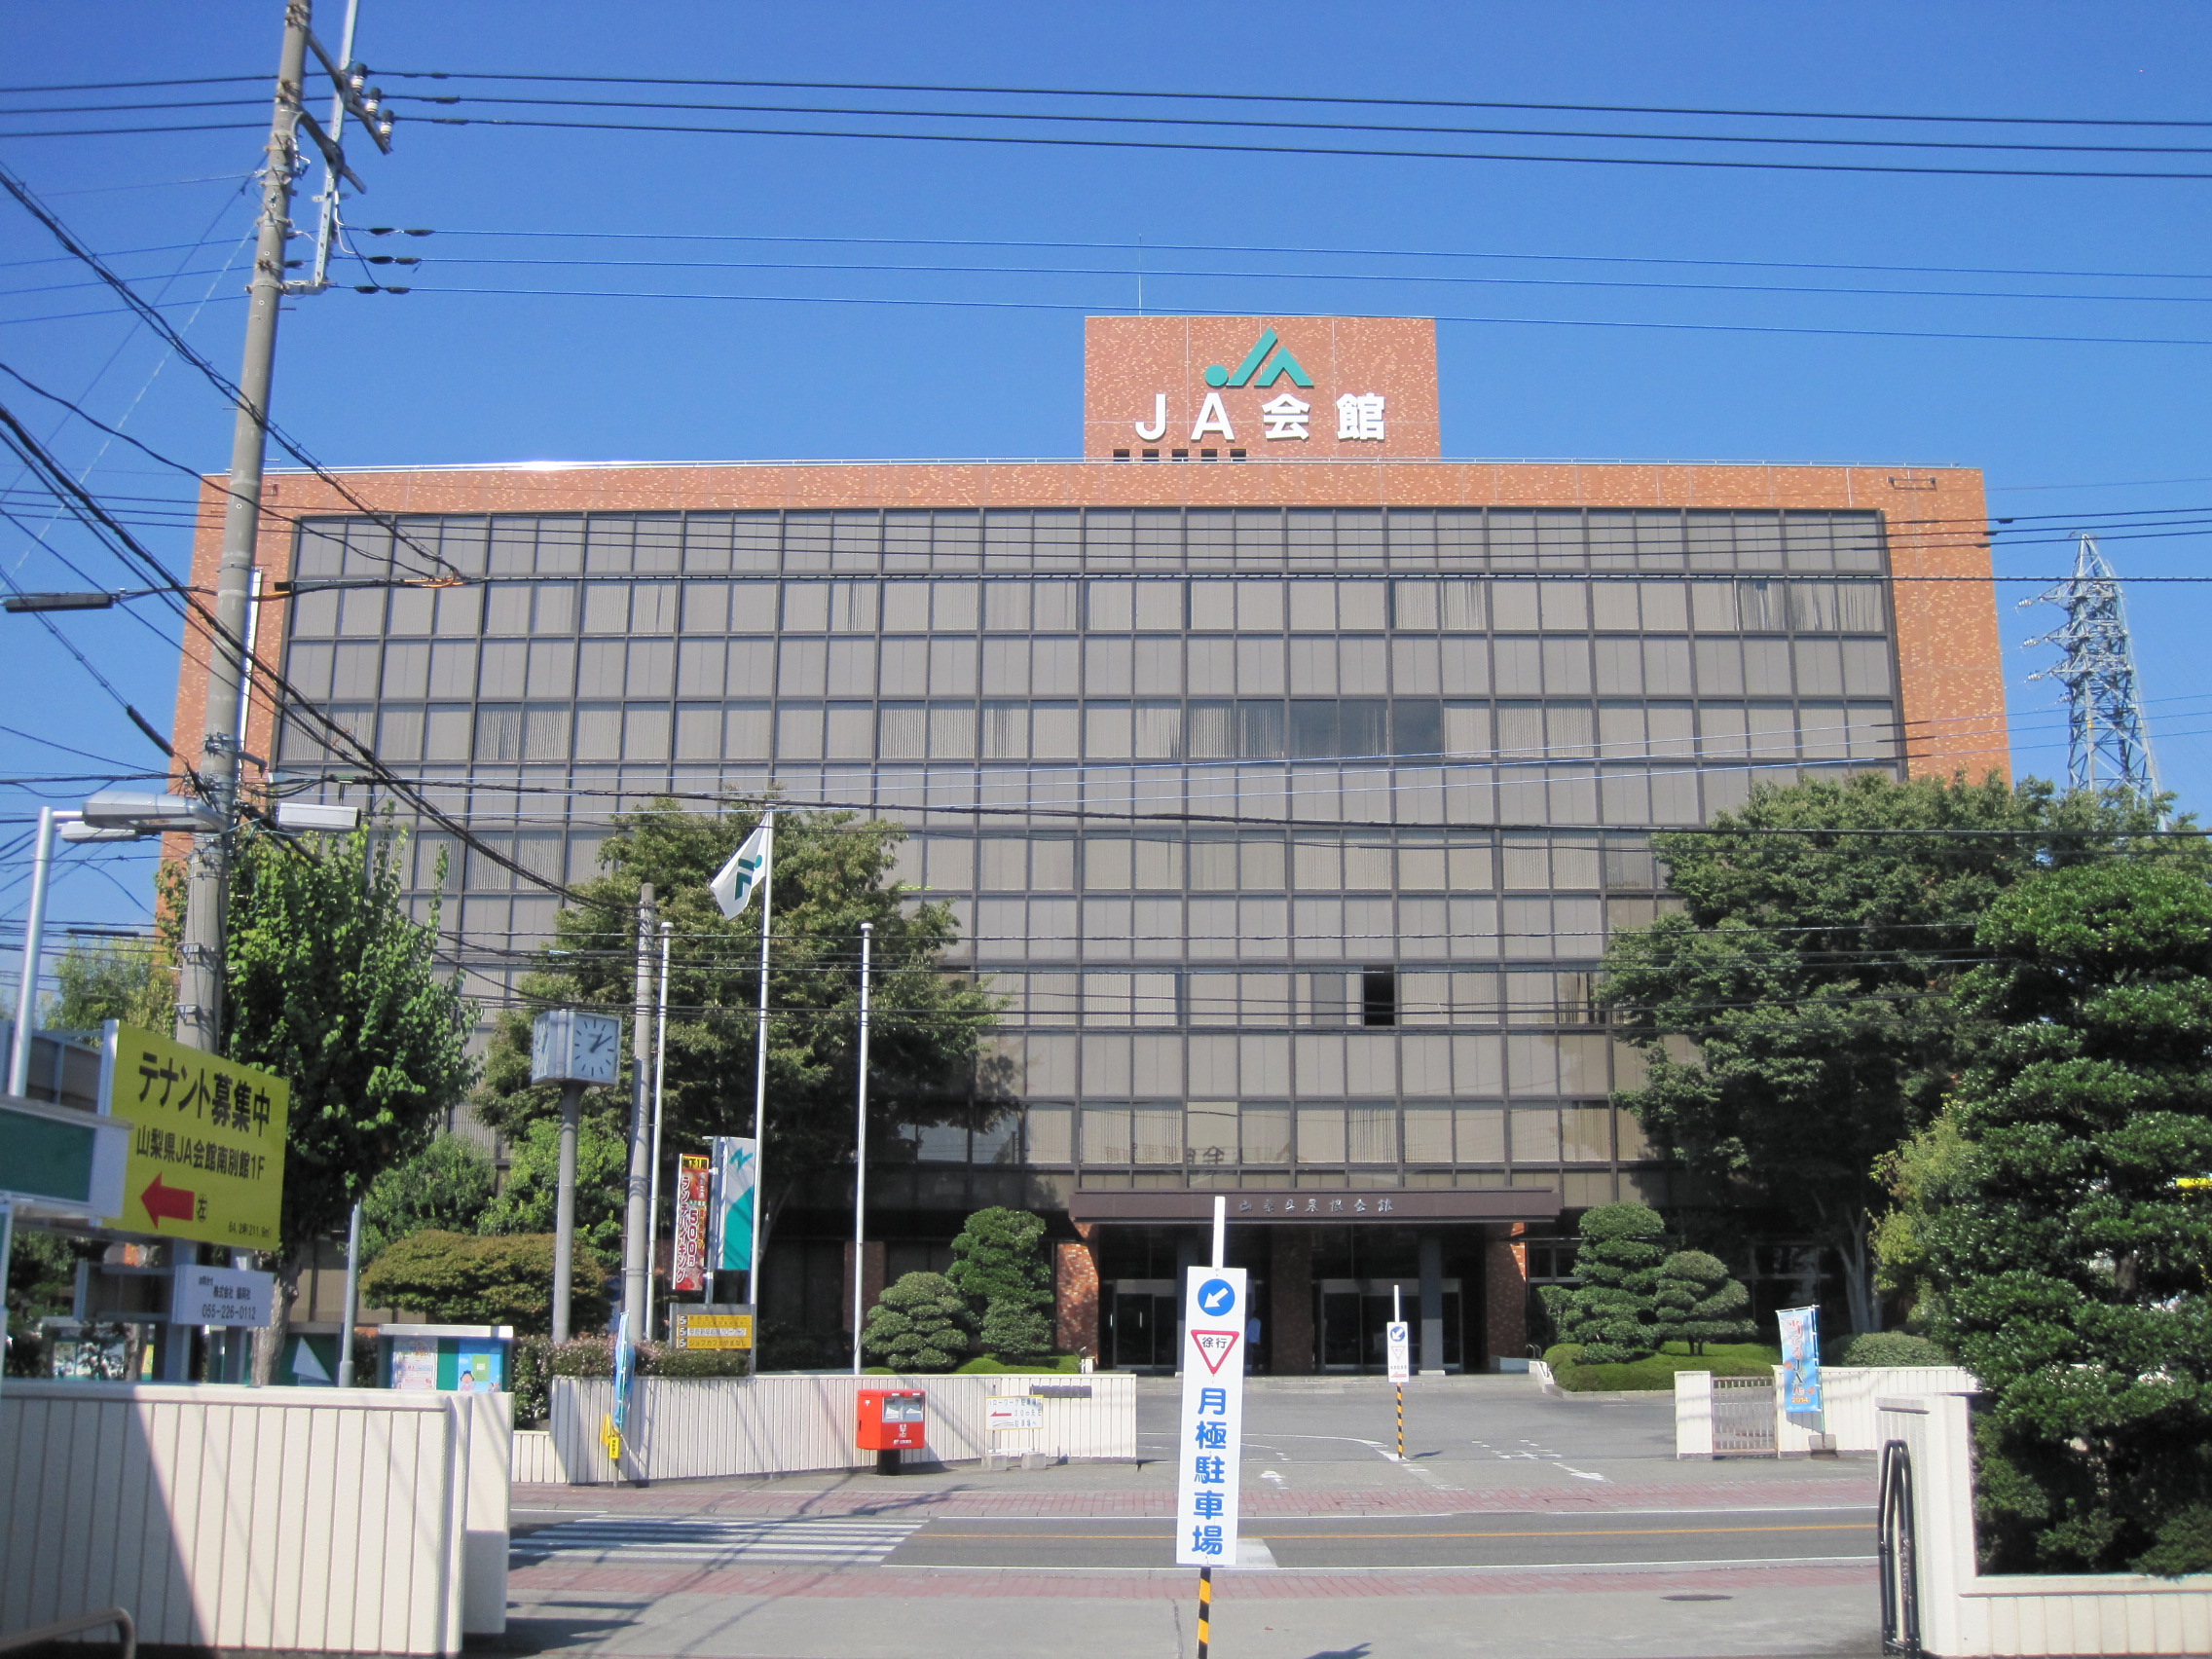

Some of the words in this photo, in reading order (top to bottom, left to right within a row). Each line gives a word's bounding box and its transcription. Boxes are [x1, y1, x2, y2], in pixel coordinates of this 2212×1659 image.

[1134, 392, 1385, 441] JA会館
[138, 1051, 271, 1137] テナント募集中
[136, 1124, 266, 1181] 山梨県JA会館南別館1F
[202, 1304, 256, 1320] 055-226-0112
[1201, 1337, 1227, 1348] 徐行
[1192, 1387, 1227, 1555] 月極駐車場
